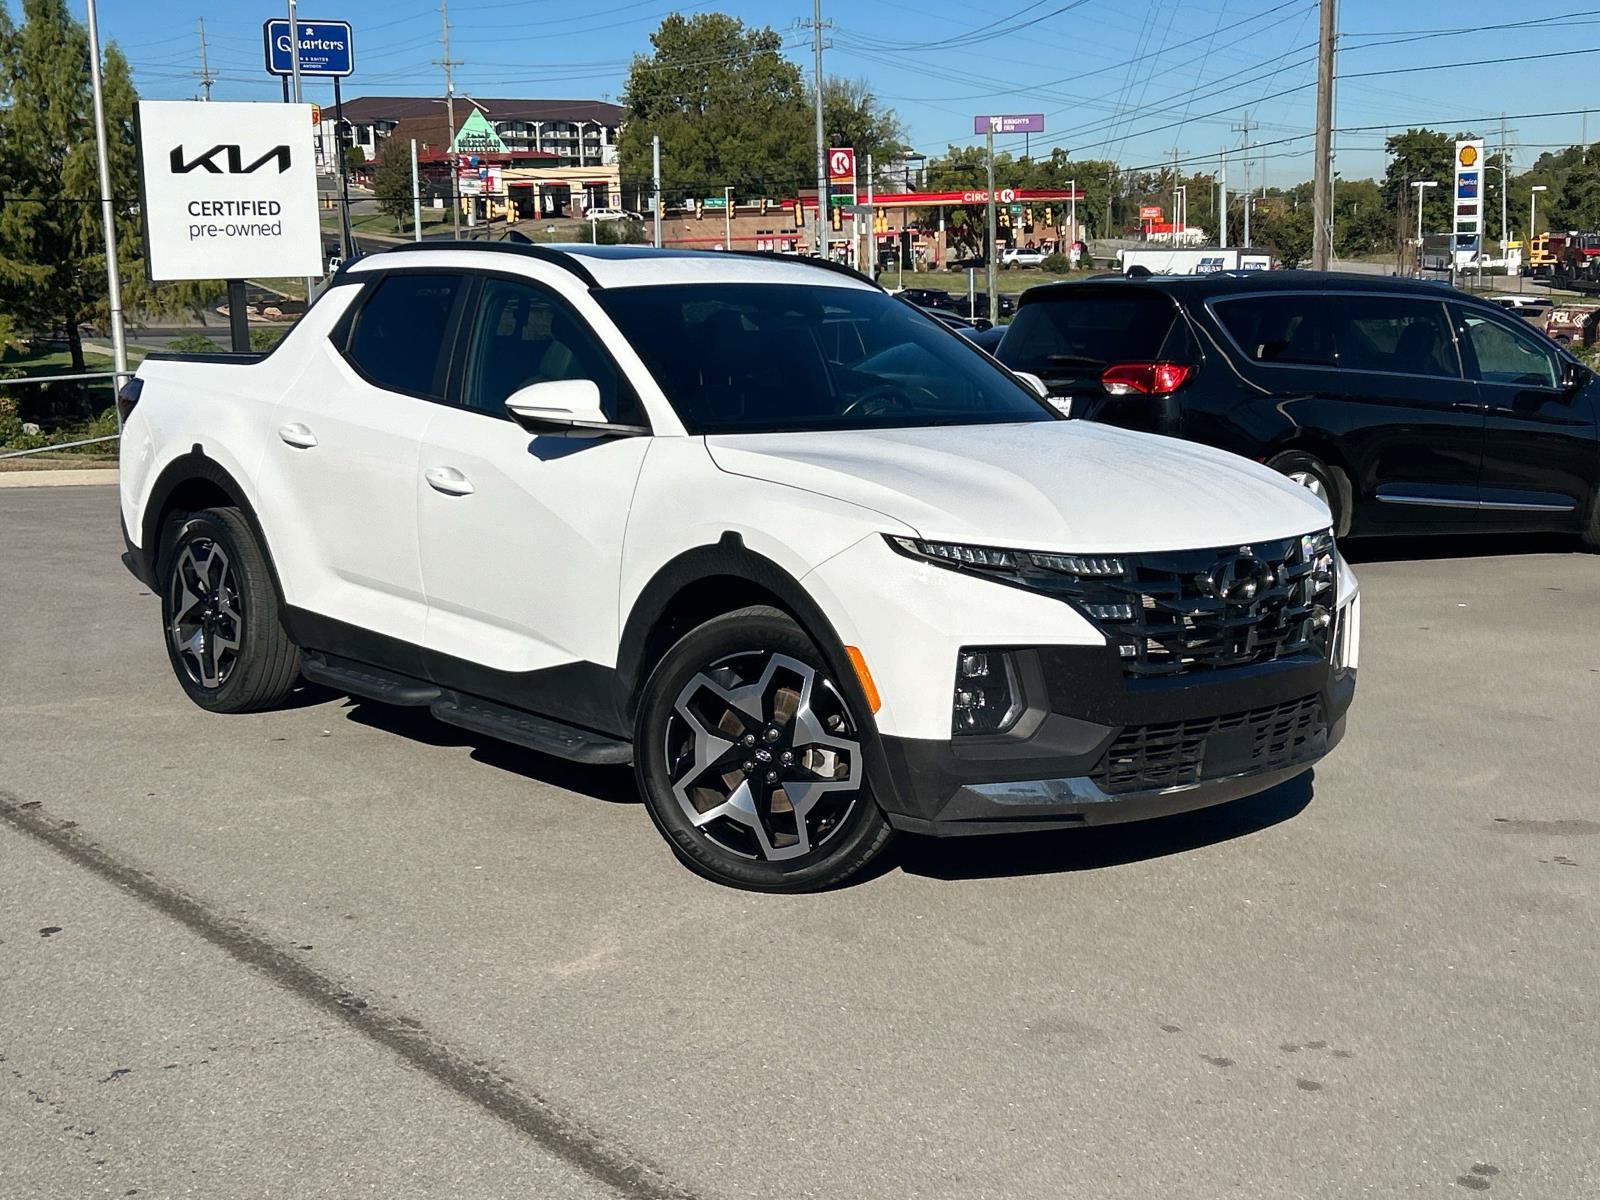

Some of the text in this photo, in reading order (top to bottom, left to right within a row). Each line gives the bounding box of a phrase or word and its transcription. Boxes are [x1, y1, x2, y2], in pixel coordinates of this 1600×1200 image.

[170, 144, 292, 174] KIA
[836, 156, 846, 170] K
[964, 192, 999, 202] CIRCE
[188, 201, 281, 216] CERTIFIED
[189, 220, 282, 241] pre-owned
